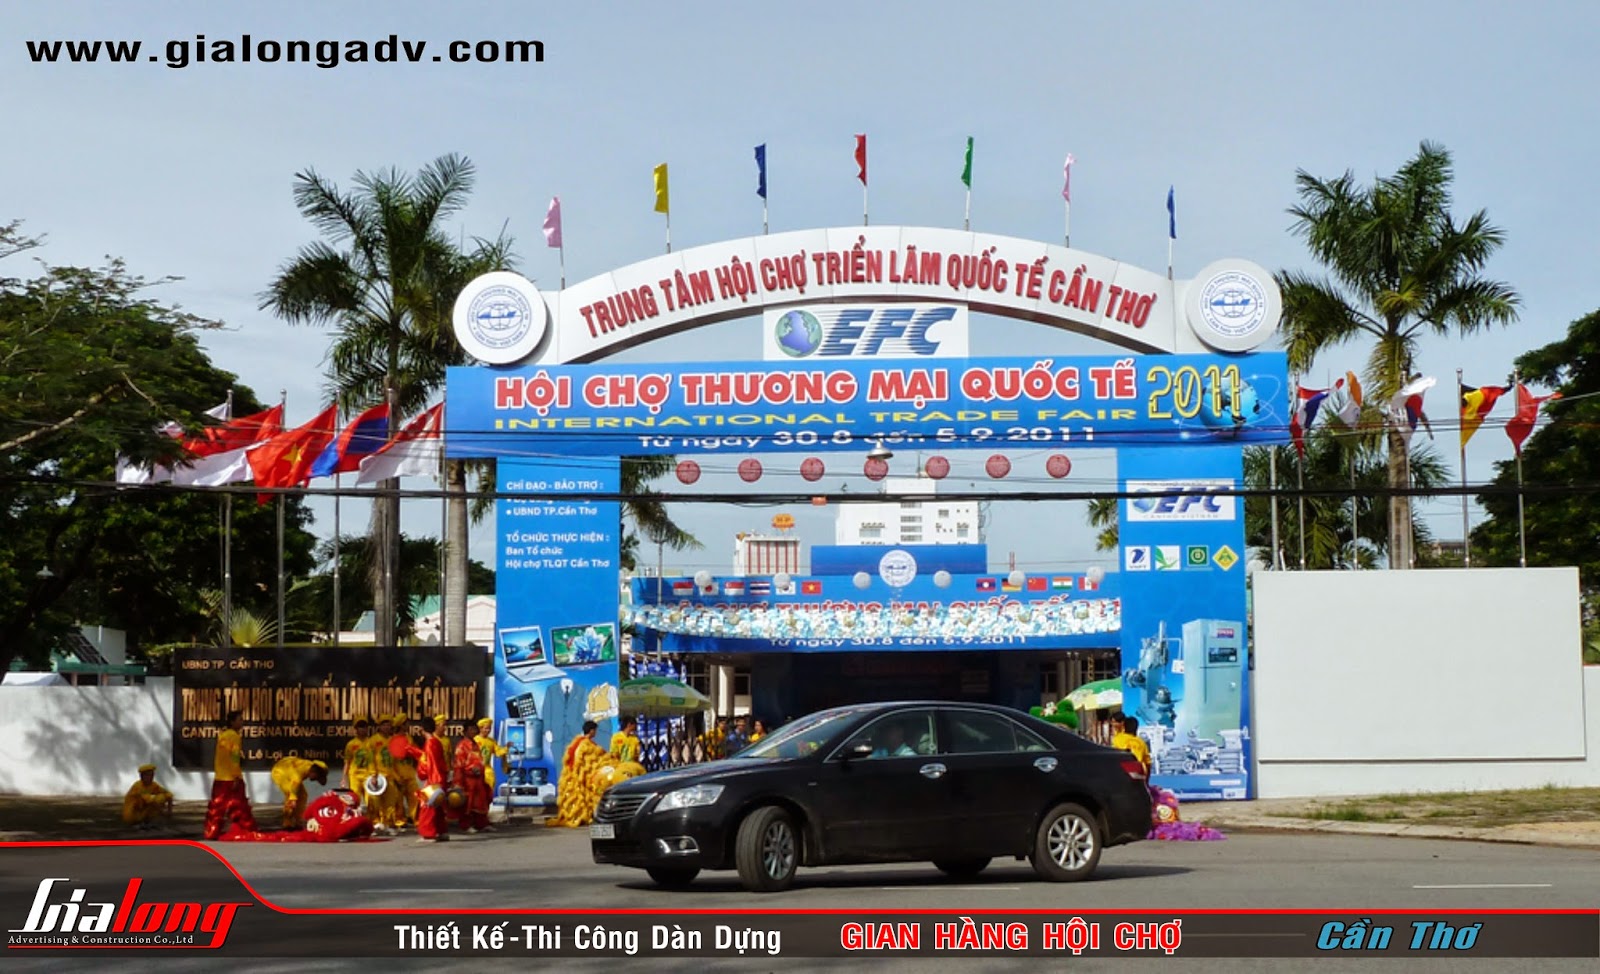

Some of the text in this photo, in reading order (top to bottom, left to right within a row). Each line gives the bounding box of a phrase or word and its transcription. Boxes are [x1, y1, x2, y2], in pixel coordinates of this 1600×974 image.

[579, 284, 660, 338] TRUNG
[659, 269, 715, 312] TÂM
[715, 255, 757, 302] HỘI
[760, 250, 807, 294] CHỢ
[812, 235, 882, 286] TRIỂN
[889, 245, 941, 285] LÃM
[947, 246, 1008, 293] QUỐC
[1015, 255, 1049, 299] TẾ
[1048, 264, 1103, 312] CẦN
[1105, 285, 1157, 328] THƠ
[818, 307, 957, 356] EFC
[495, 358, 1241, 419] HỘI CHỢ THƯƠNG MẠI QUỐC TẾ 2011
[495, 409, 1136, 430] INTERNATIONAL TRADE FAIR
[638, 435, 673, 448] Từ
[772, 430, 853, 446] 30.8
[935, 425, 1094, 443] 5.9.2011
[506, 479, 523, 490] CHỈ
[525, 481, 546, 491] ĐẠO
[554, 478, 575, 490] BẢO
[577, 480, 598, 491] TRỢ
[1154, 485, 1229, 513] EFC
[513, 507, 541, 516] UBND
[579, 506, 597, 516] Thơ
[521, 531, 549, 542] CHỨC
[552, 532, 578, 543] THỰC
[580, 531, 603, 543] HIỆN
[506, 547, 524, 556] Ban
[505, 558, 610, 569] Hội chợ TLQT Cần Thơ
[182, 660, 210, 669] UBND
[182, 672, 477, 725] TRUNG TÂM HỘI CHỢ TRIỂN LÃM QUỐC TẾ CẦN THƠ
